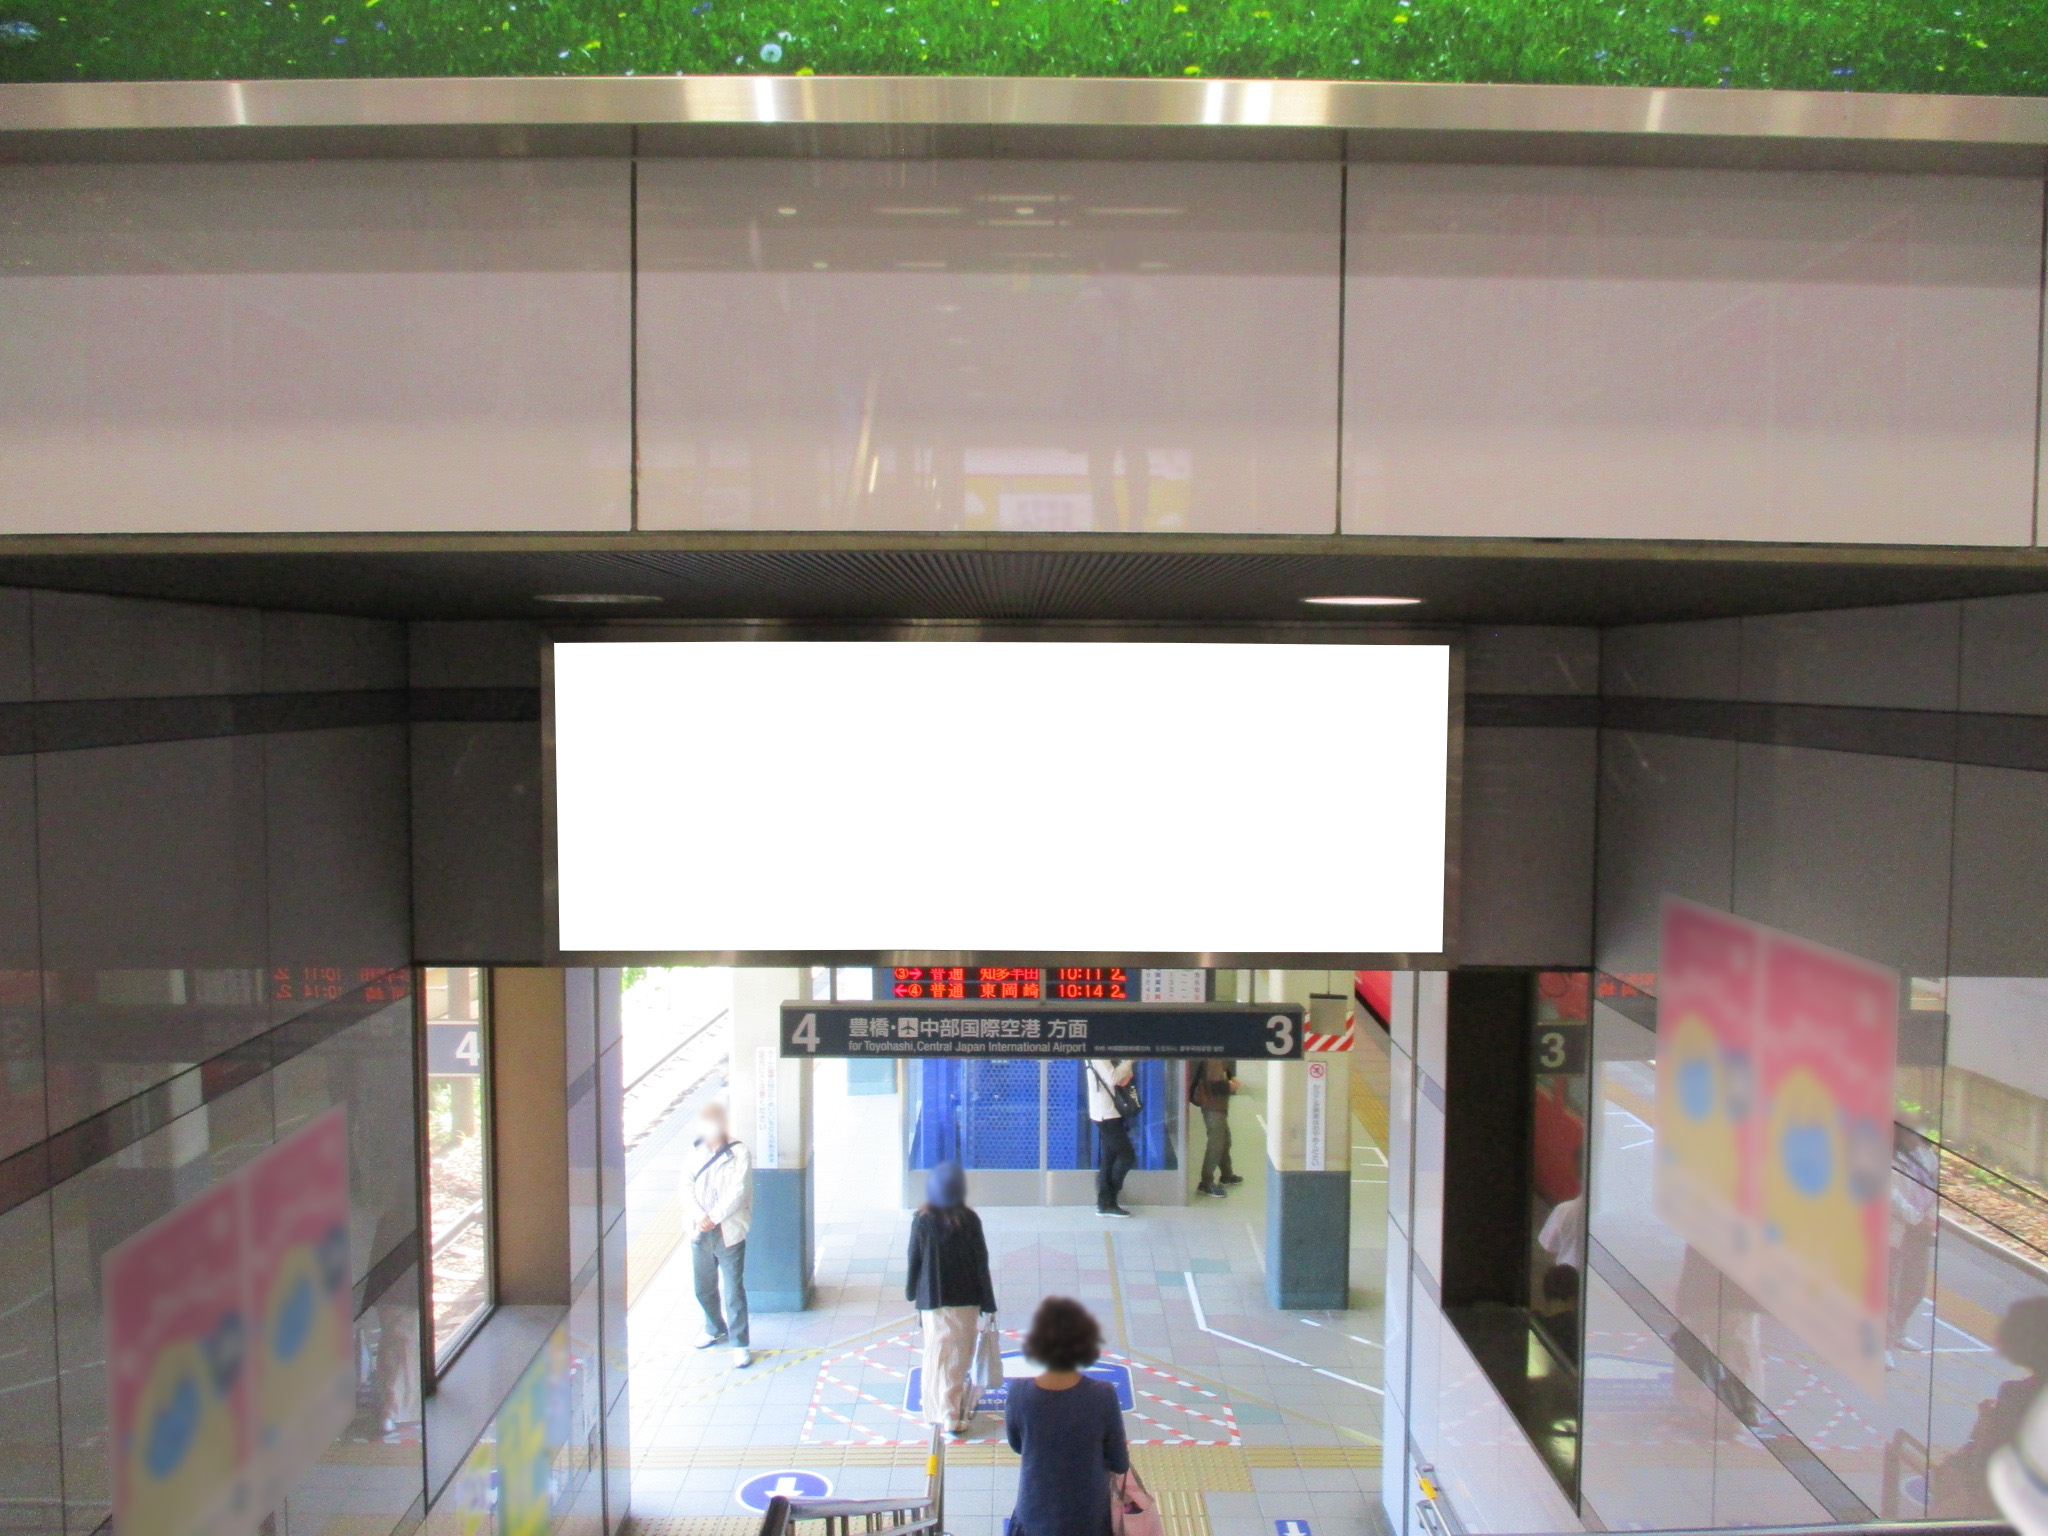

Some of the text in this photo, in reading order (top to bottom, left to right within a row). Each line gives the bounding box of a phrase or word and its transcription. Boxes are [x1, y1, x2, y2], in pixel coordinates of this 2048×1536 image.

[1060, 968, 1101, 980] 10:11
[930, 983, 965, 998] 普通
[980, 983, 1039, 998] 東岡崎
[1060, 984, 1103, 997] 10:14
[791, 1013, 821, 1053] 4
[1047, 1019, 1089, 1039] 方面
[1265, 1015, 1294, 1056] 3
[455, 1031, 480, 1067] 4
[849, 1040, 863, 1051] for
[956, 1041, 986, 1054] Japan
[988, 1041, 1050, 1052] International
[1053, 1041, 1087, 1054] Airport
[1541, 1032, 1566, 1068] 3
